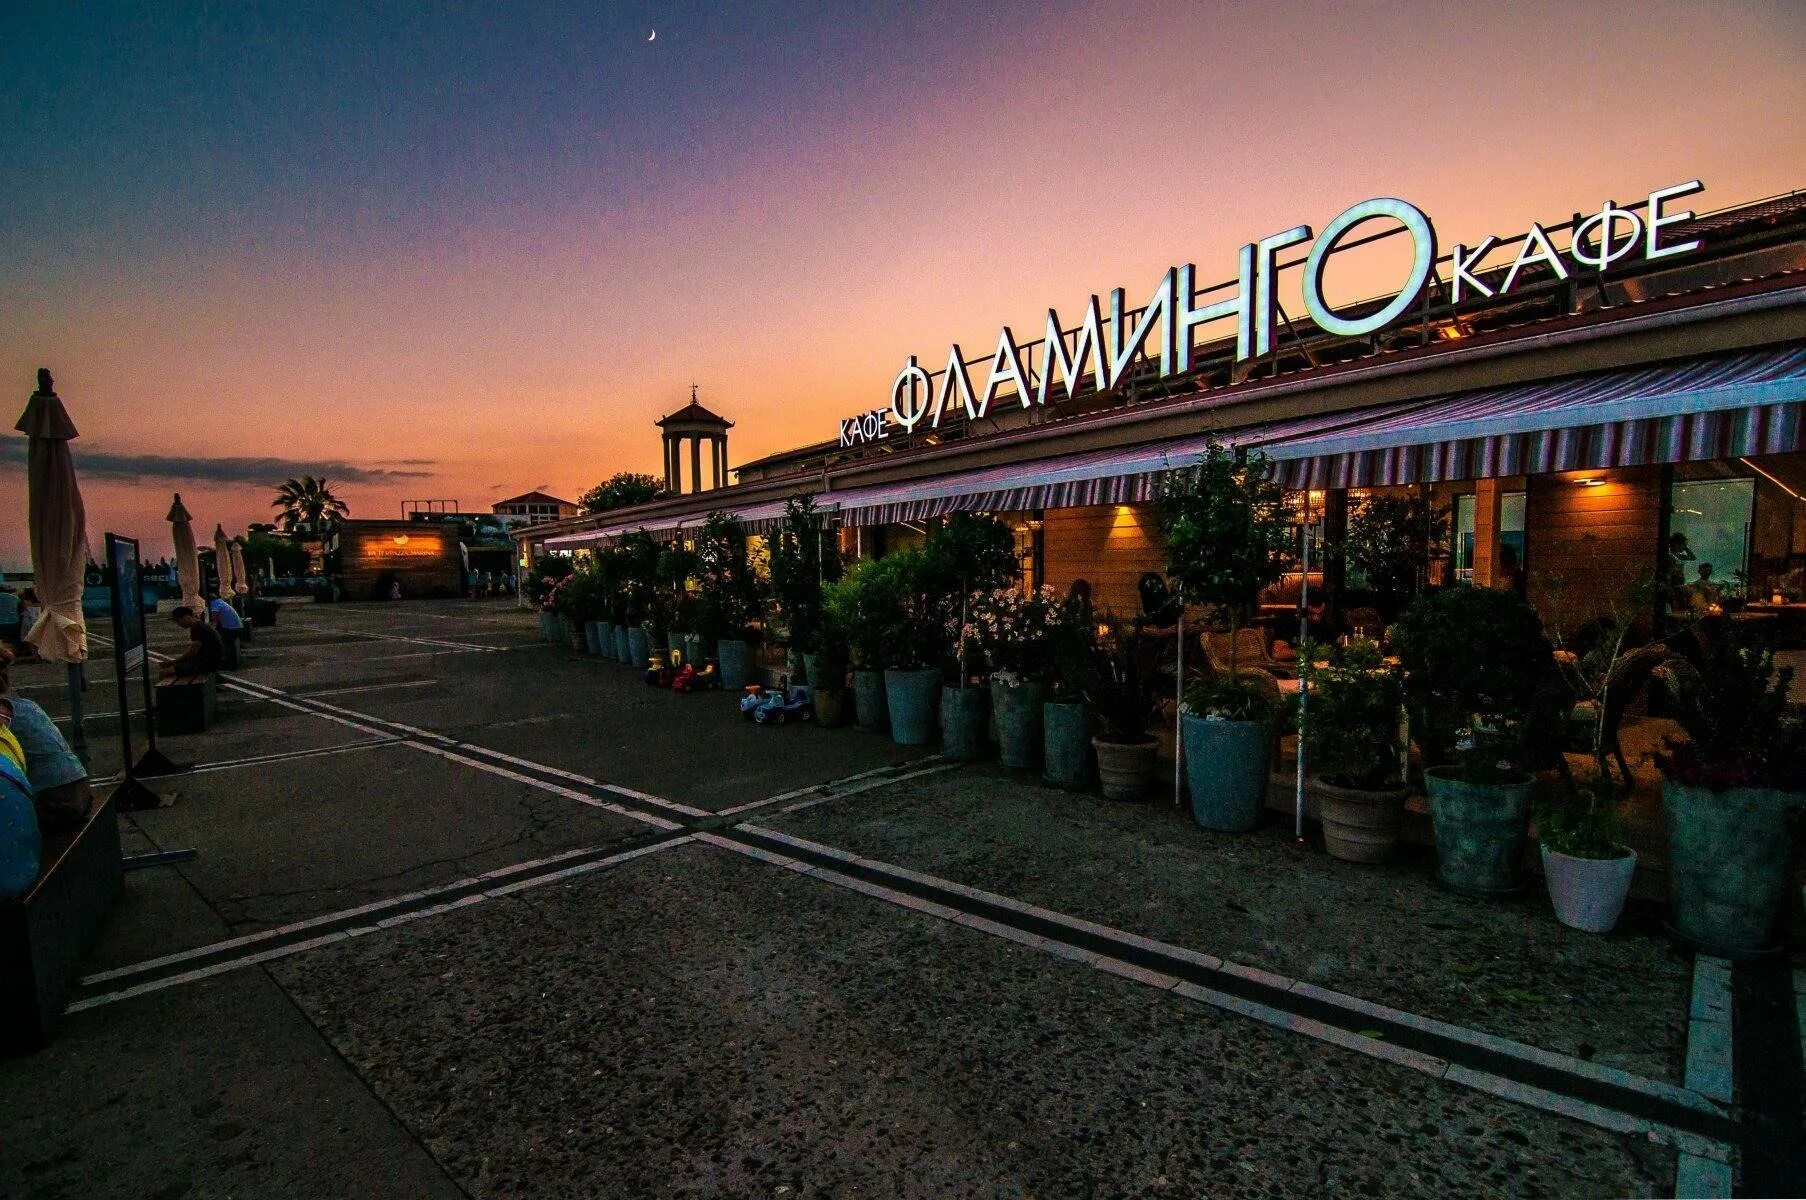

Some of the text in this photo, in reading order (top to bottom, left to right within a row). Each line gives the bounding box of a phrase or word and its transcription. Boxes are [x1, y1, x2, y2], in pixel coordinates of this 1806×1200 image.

[840, 179, 1702, 447] КАФЕ ФЛАМИНГО КАФЕ
